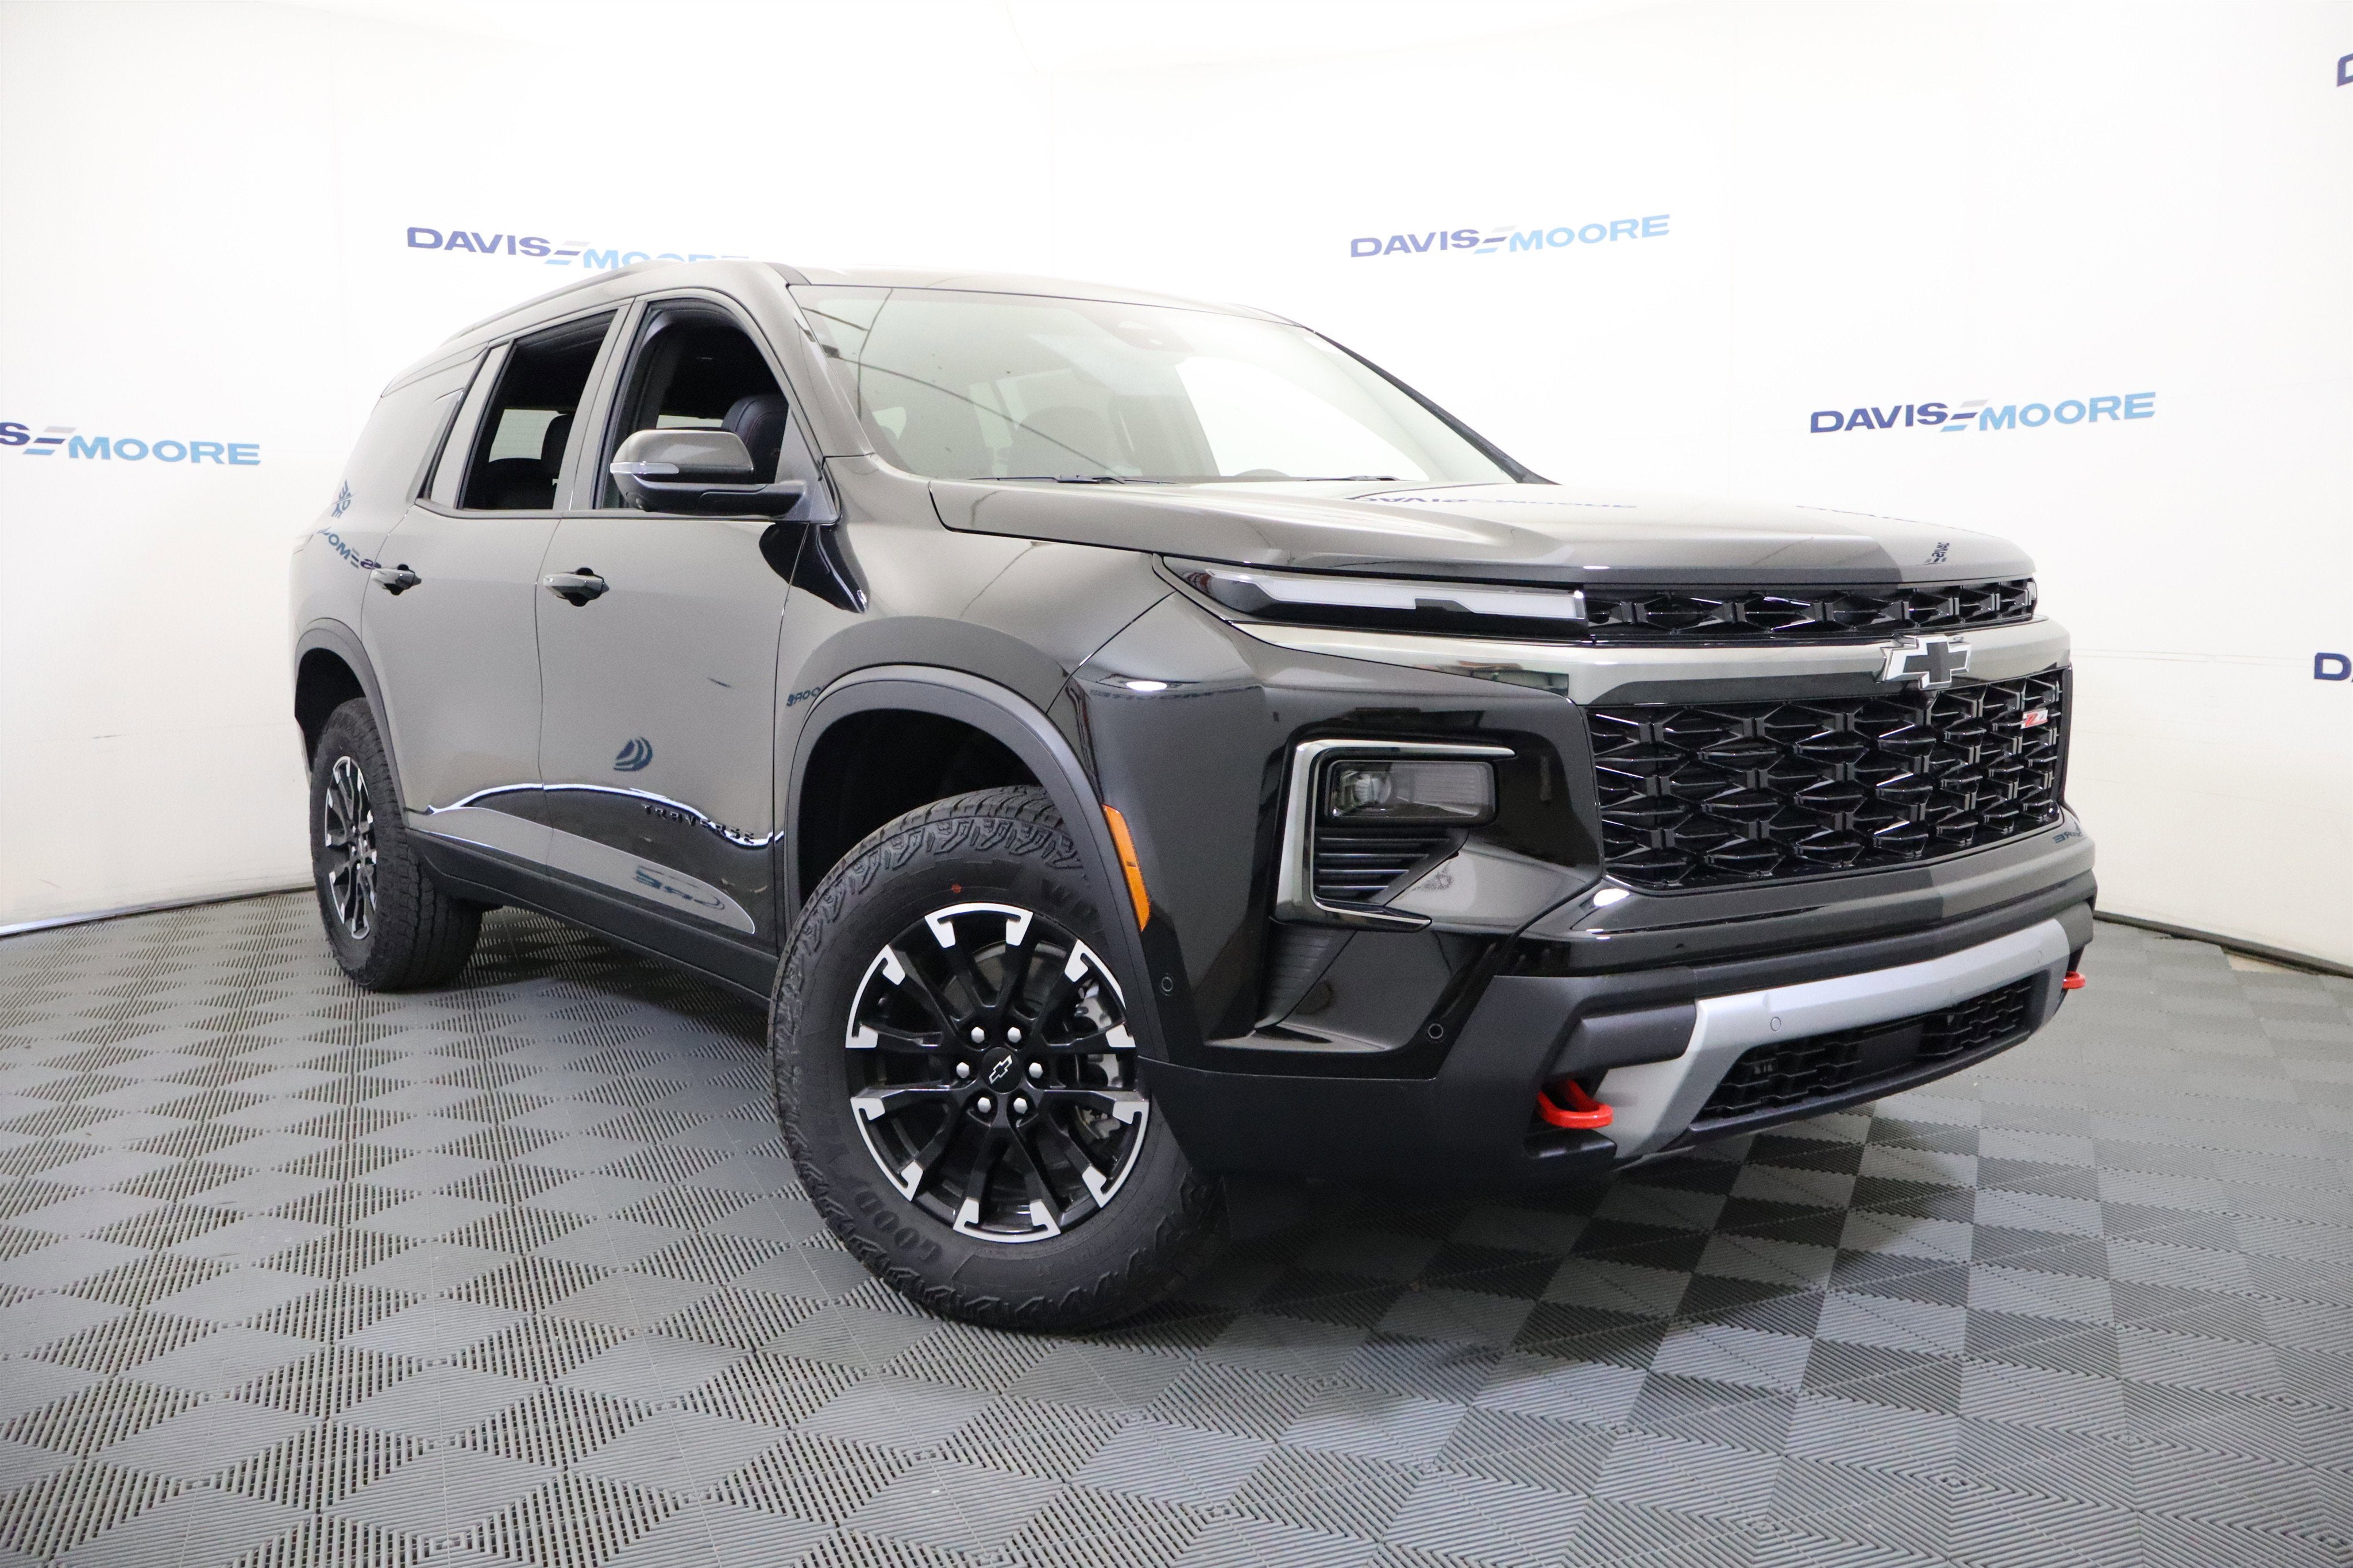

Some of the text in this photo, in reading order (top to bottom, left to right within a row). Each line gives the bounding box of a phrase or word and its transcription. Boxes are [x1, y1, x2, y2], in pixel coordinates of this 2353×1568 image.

[406, 226, 551, 257] DAVIS
[1351, 214, 1670, 257] DAVIS MOORE
[1810, 391, 2156, 434] DAVIS MOORE
[68, 435, 261, 466] MOORE
